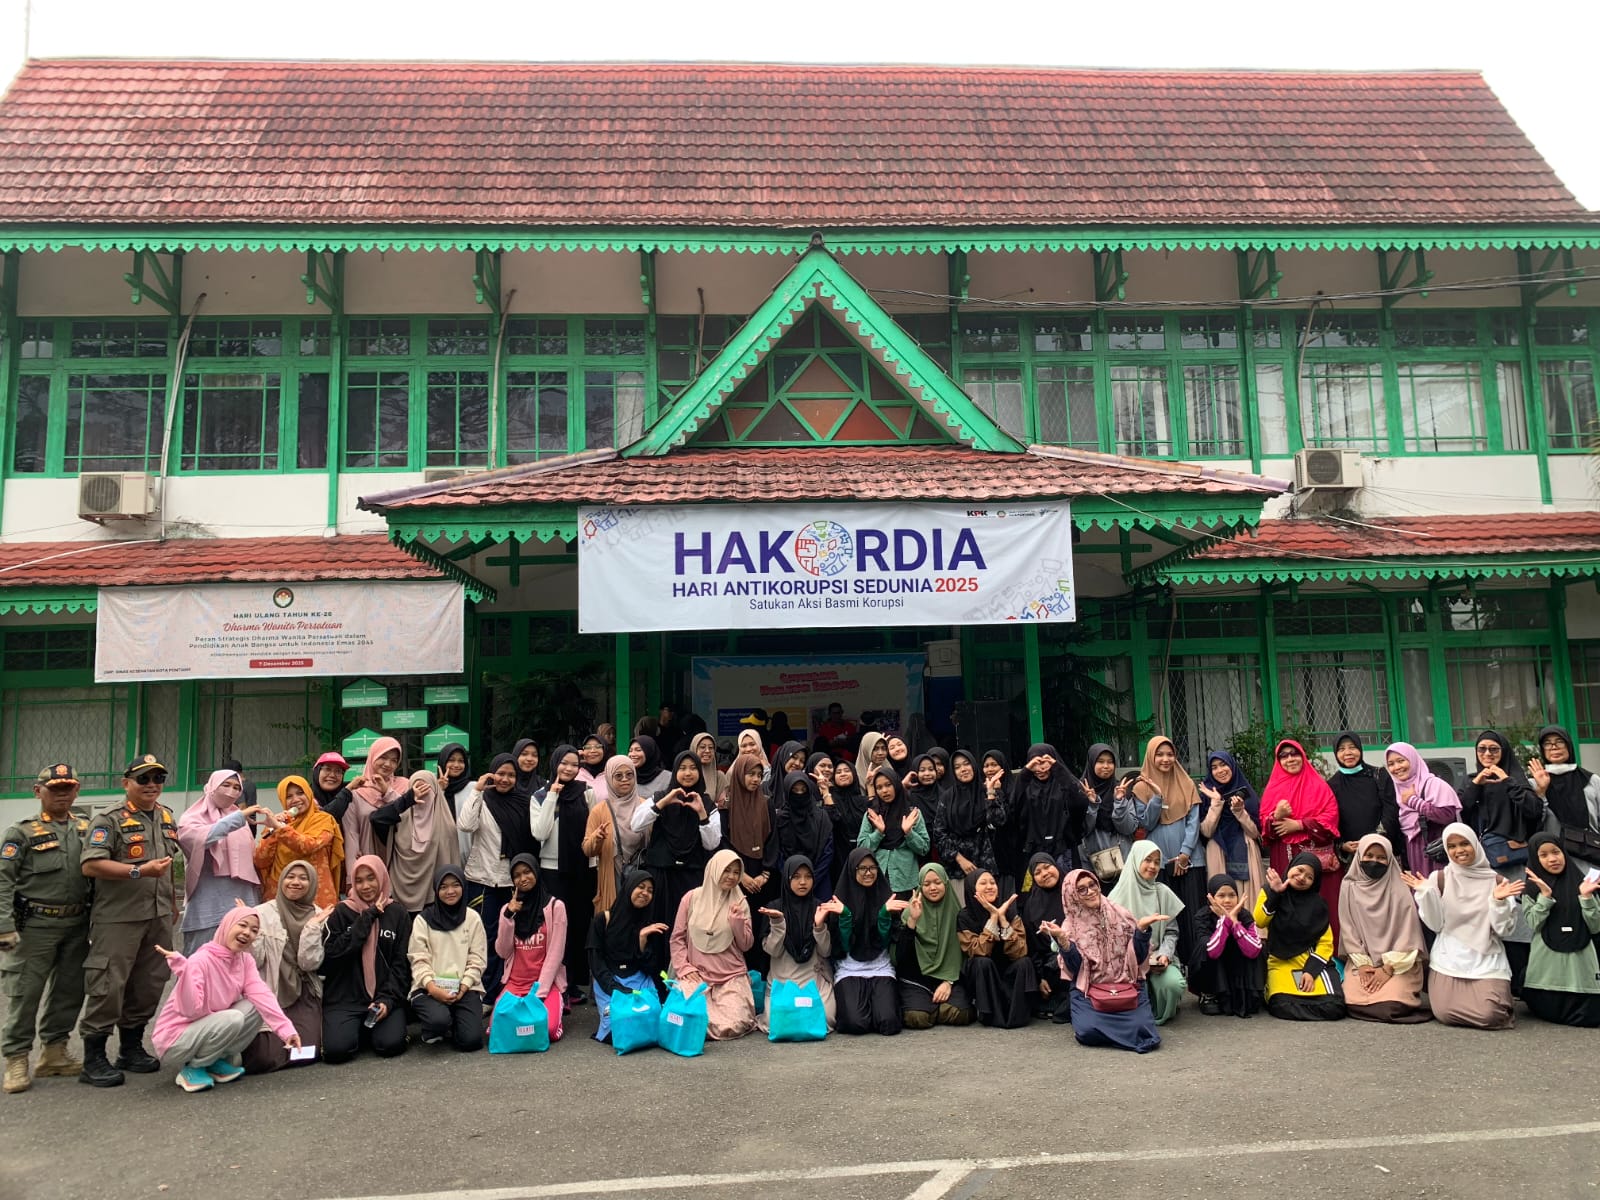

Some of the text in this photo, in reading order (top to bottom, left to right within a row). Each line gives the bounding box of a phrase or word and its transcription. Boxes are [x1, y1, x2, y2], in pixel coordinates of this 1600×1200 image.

[672, 577, 979, 598] HARI ANTIKORUPSI SEDUNIA 2025
[749, 596, 904, 610] Satukan Aksi Basmi Korupsi
[222, 622, 260, 632] Dharma
